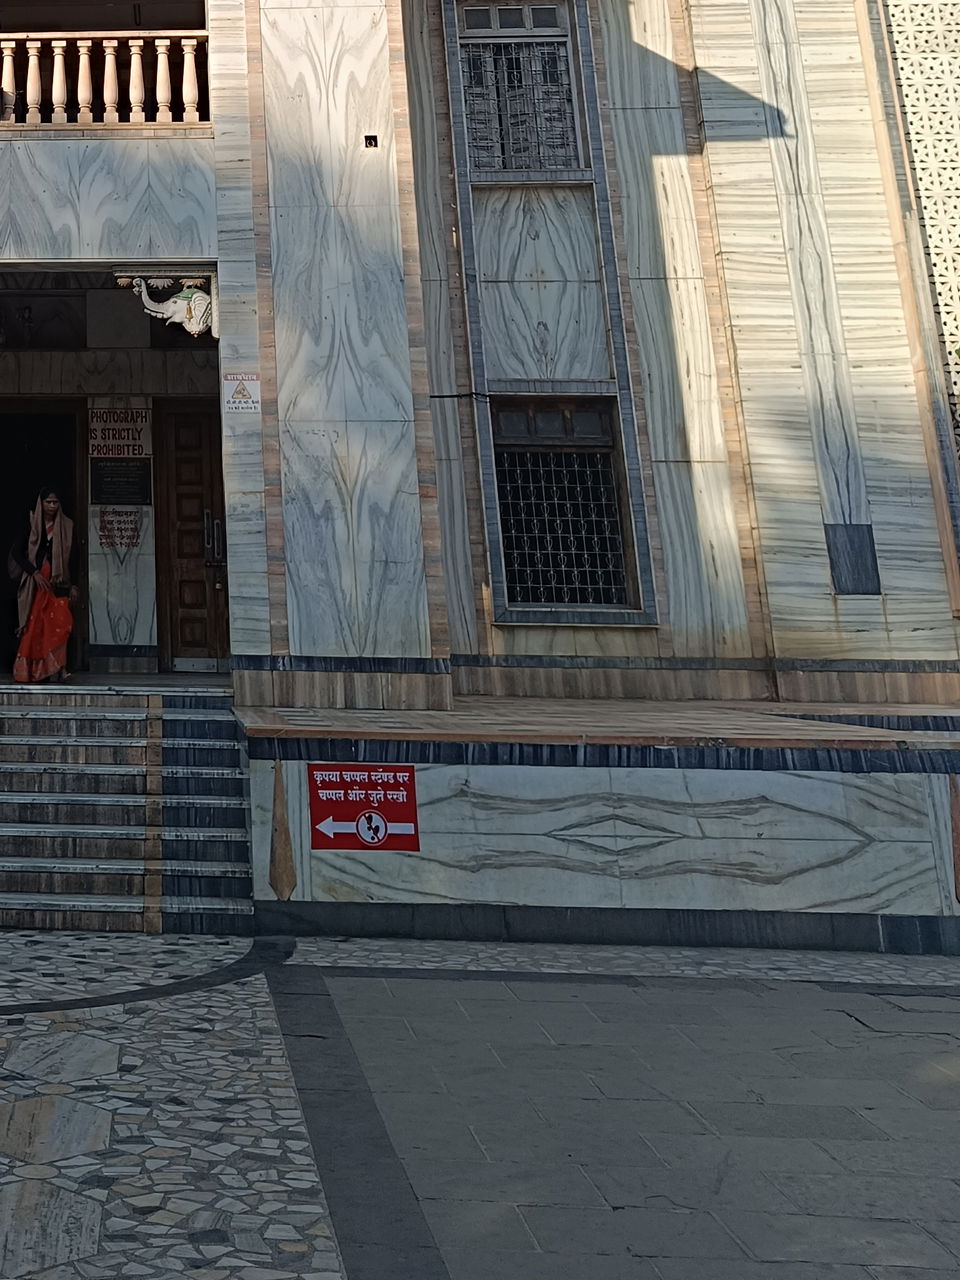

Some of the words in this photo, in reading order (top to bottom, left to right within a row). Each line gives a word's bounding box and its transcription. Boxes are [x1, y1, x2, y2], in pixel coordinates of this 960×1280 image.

[91, 410, 148, 424] PHOTOGRAPH
[89, 428, 98, 440] IS
[100, 427, 144, 441] STRICTLY
[91, 444, 144, 456] PROHIBITED
[313, 771, 340, 786] कृपया
[342, 771, 369, 783] चप्पल
[396, 772, 410, 784] पर
[318, 789, 344, 802] चप्पल
[386, 786, 407, 803] रखो
